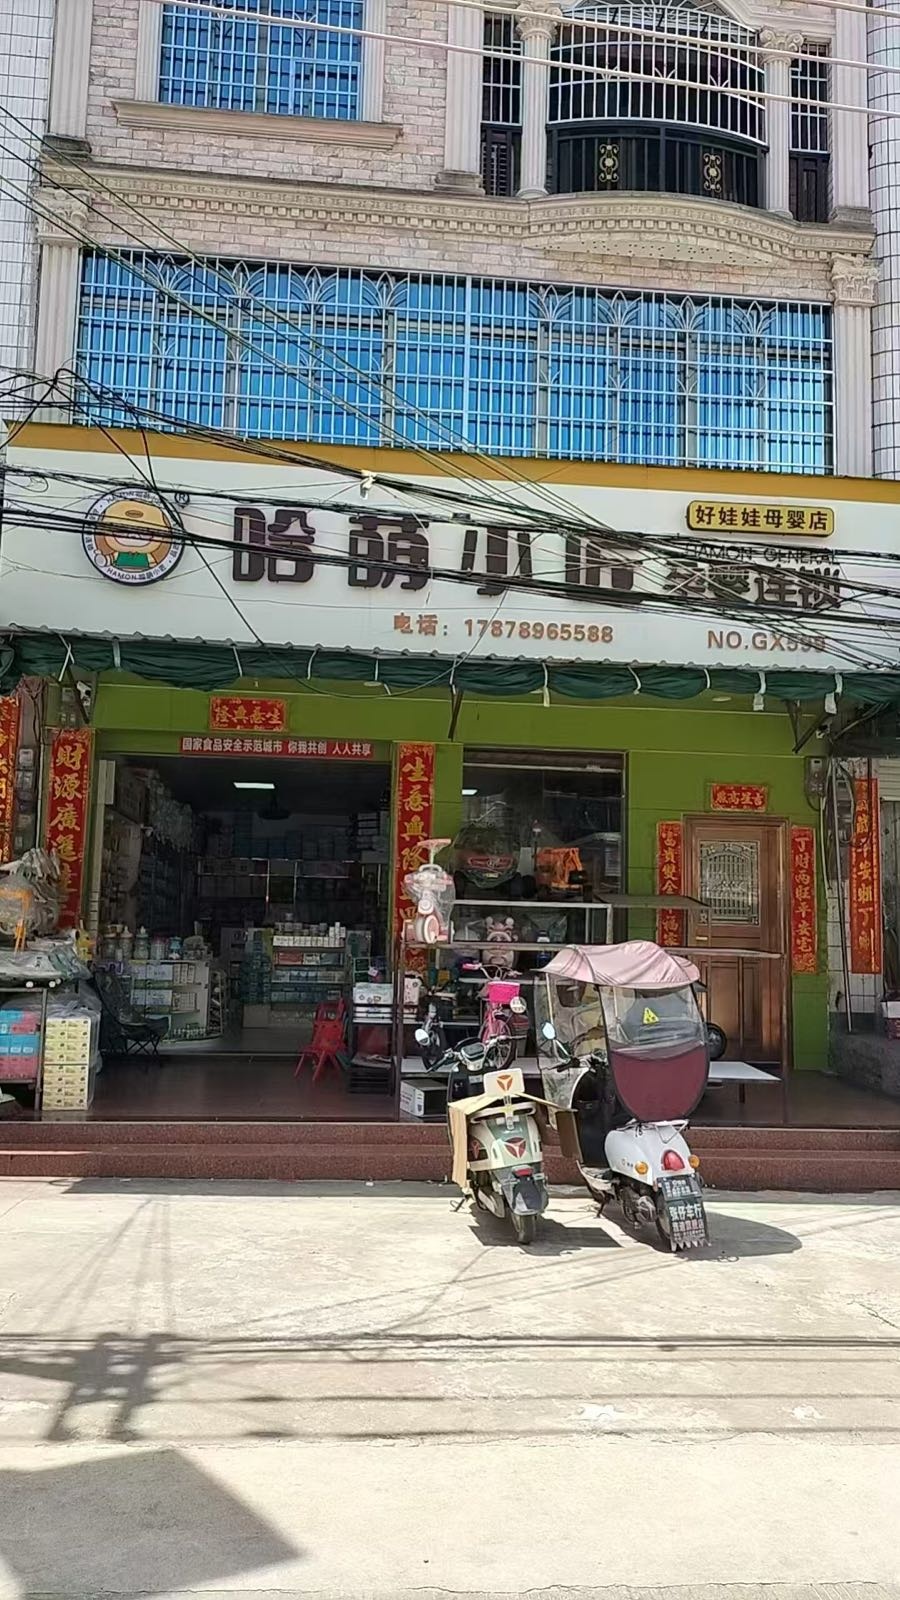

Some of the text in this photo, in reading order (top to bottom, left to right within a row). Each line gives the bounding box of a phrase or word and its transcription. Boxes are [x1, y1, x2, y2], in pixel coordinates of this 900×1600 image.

[695, 504, 829, 531] 好娃娃母婴店
[464, 618, 614, 643] 17878965588
[182, 737, 372, 757] 国家食品安全示范城市 你我共创 人人共享
